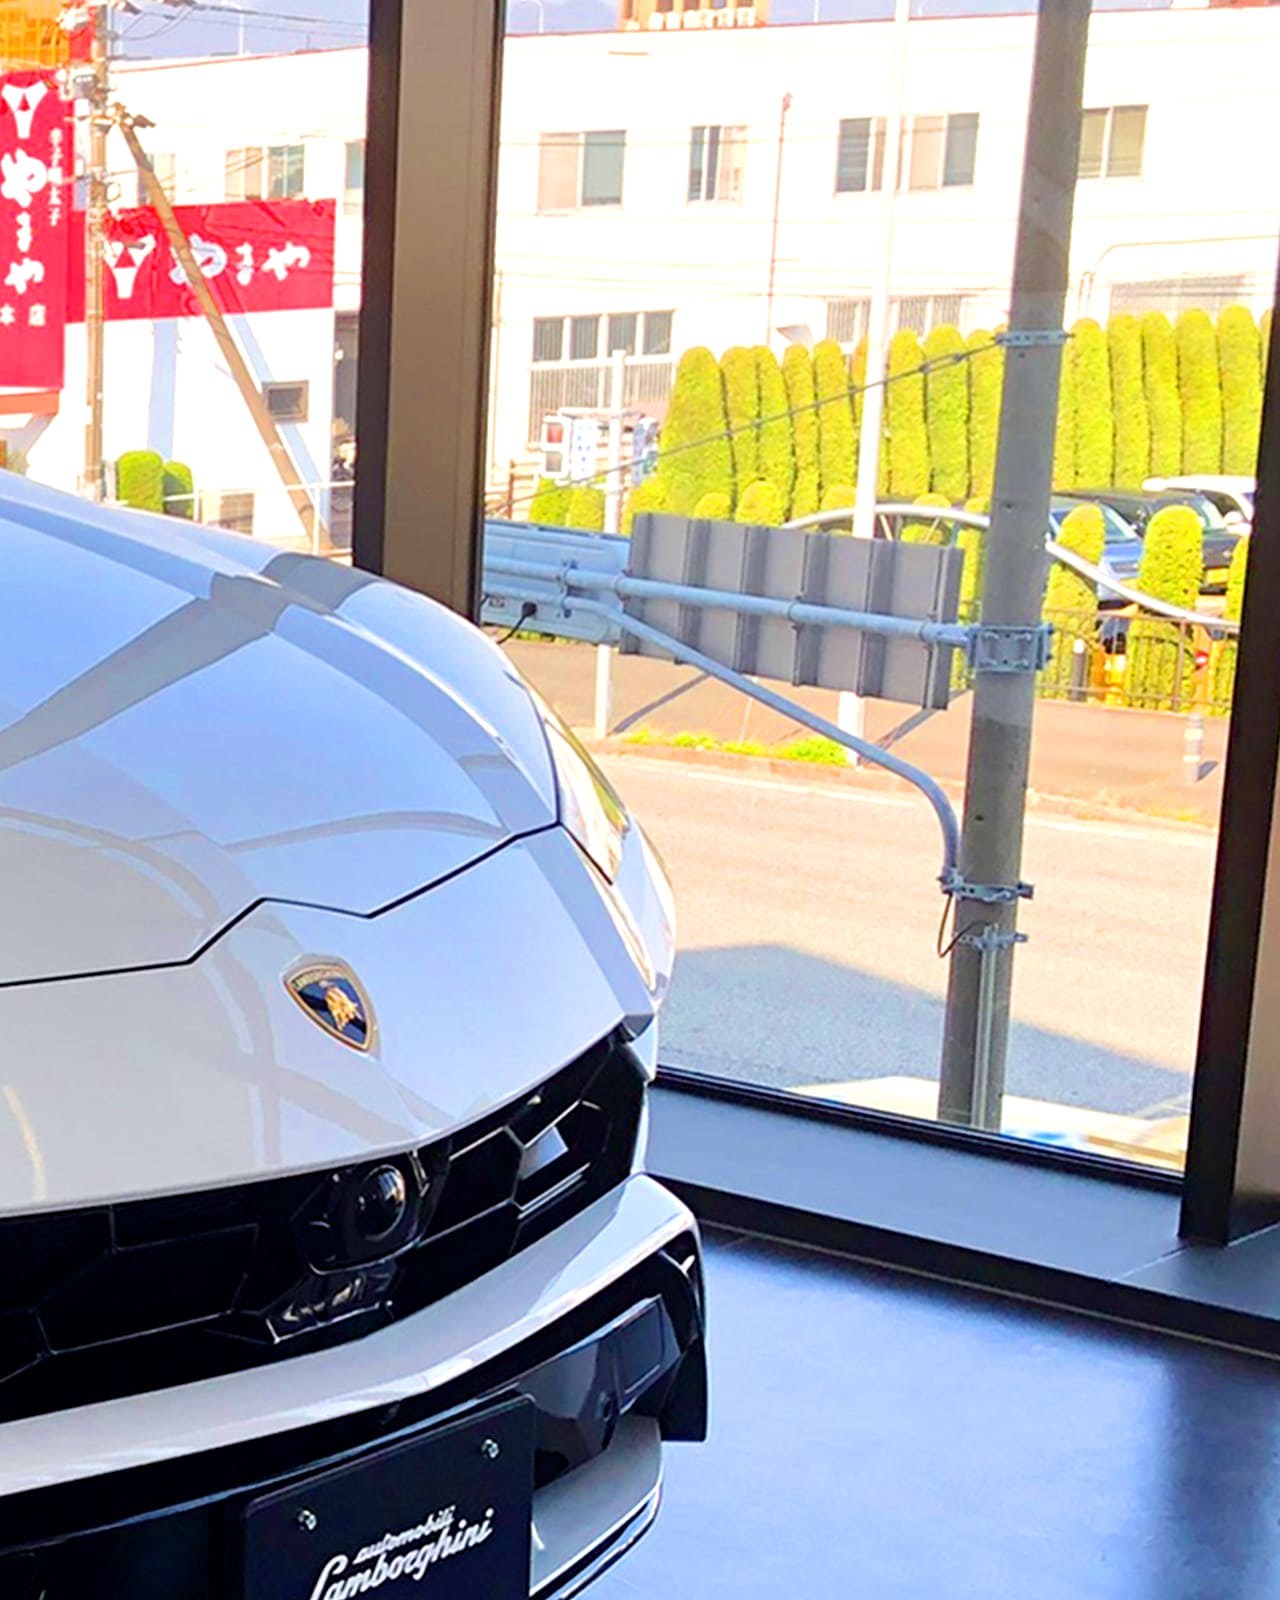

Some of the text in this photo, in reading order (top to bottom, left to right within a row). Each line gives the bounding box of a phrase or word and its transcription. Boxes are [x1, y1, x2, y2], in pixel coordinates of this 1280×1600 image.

[0, 147, 47, 295] やまや
[168, 233, 310, 286] やまや
[309, 1507, 494, 1600] Lamborghini
[352, 1504, 457, 1565] automobili
